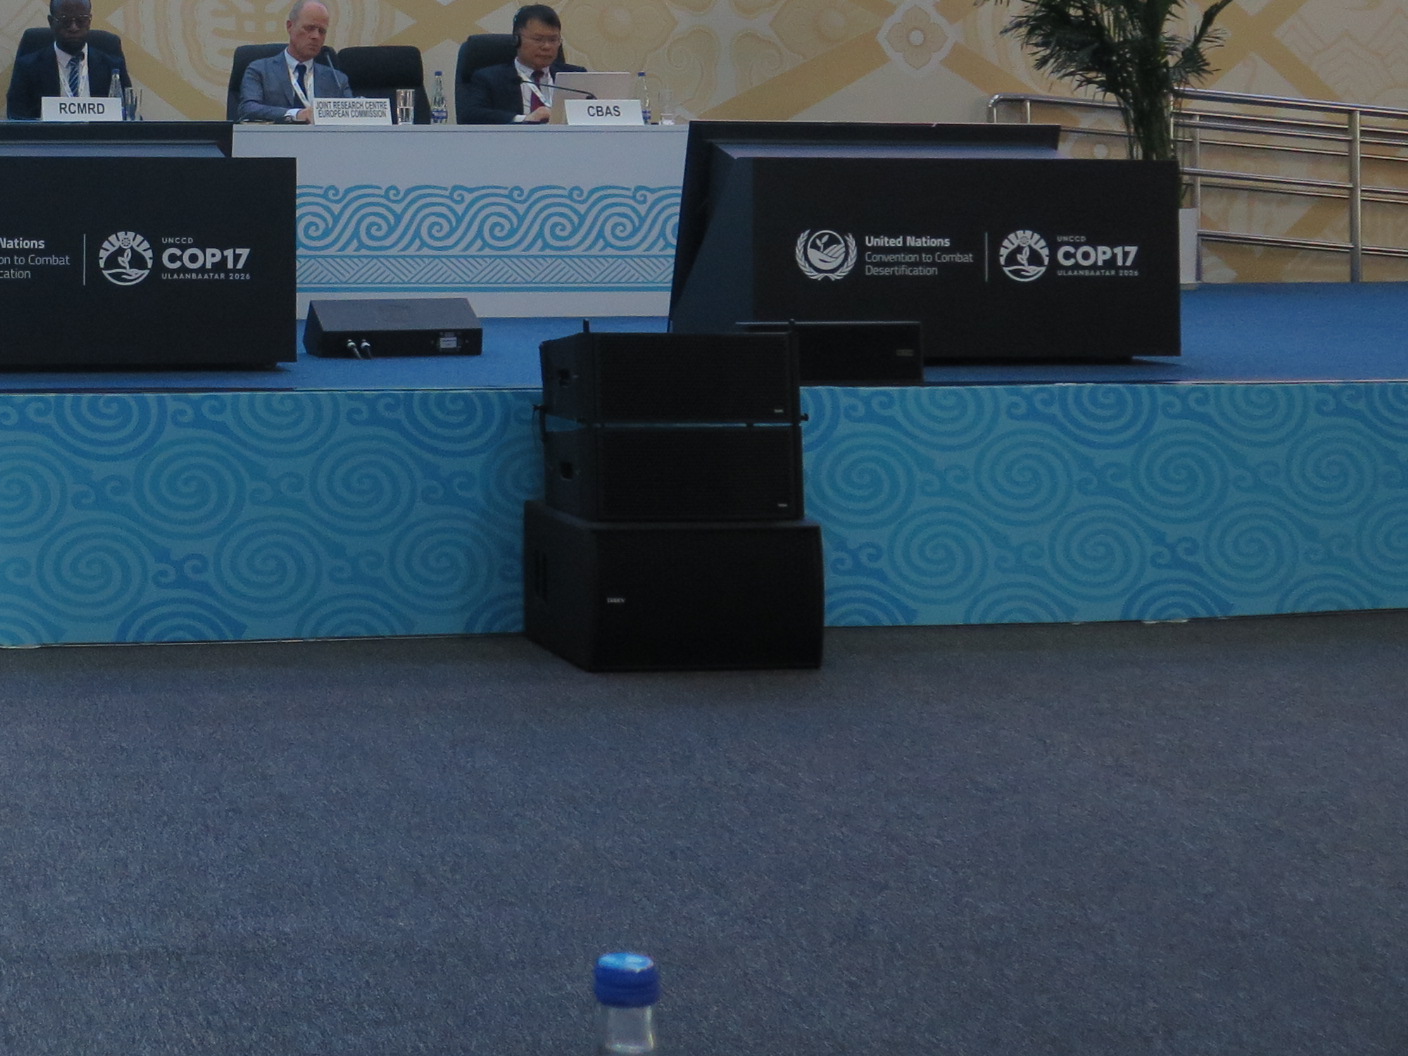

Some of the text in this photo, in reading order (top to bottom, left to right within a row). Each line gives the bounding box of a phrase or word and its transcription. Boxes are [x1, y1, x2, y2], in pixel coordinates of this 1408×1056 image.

[59, 103, 104, 114] RCMRD
[315, 101, 388, 110] JOINT RESEARCH CENTRE
[318, 110, 386, 118] EUROPEAN COMMISSION
[587, 106, 620, 116] CBAS
[865, 236, 950, 247] United Nations
[14, 255, 25, 265] to
[28, 254, 70, 265] Combat
[162, 248, 250, 269] COP17
[865, 252, 973, 262] Convention to Combat
[1057, 246, 1138, 266] COP17
[865, 265, 938, 275] Desertification
